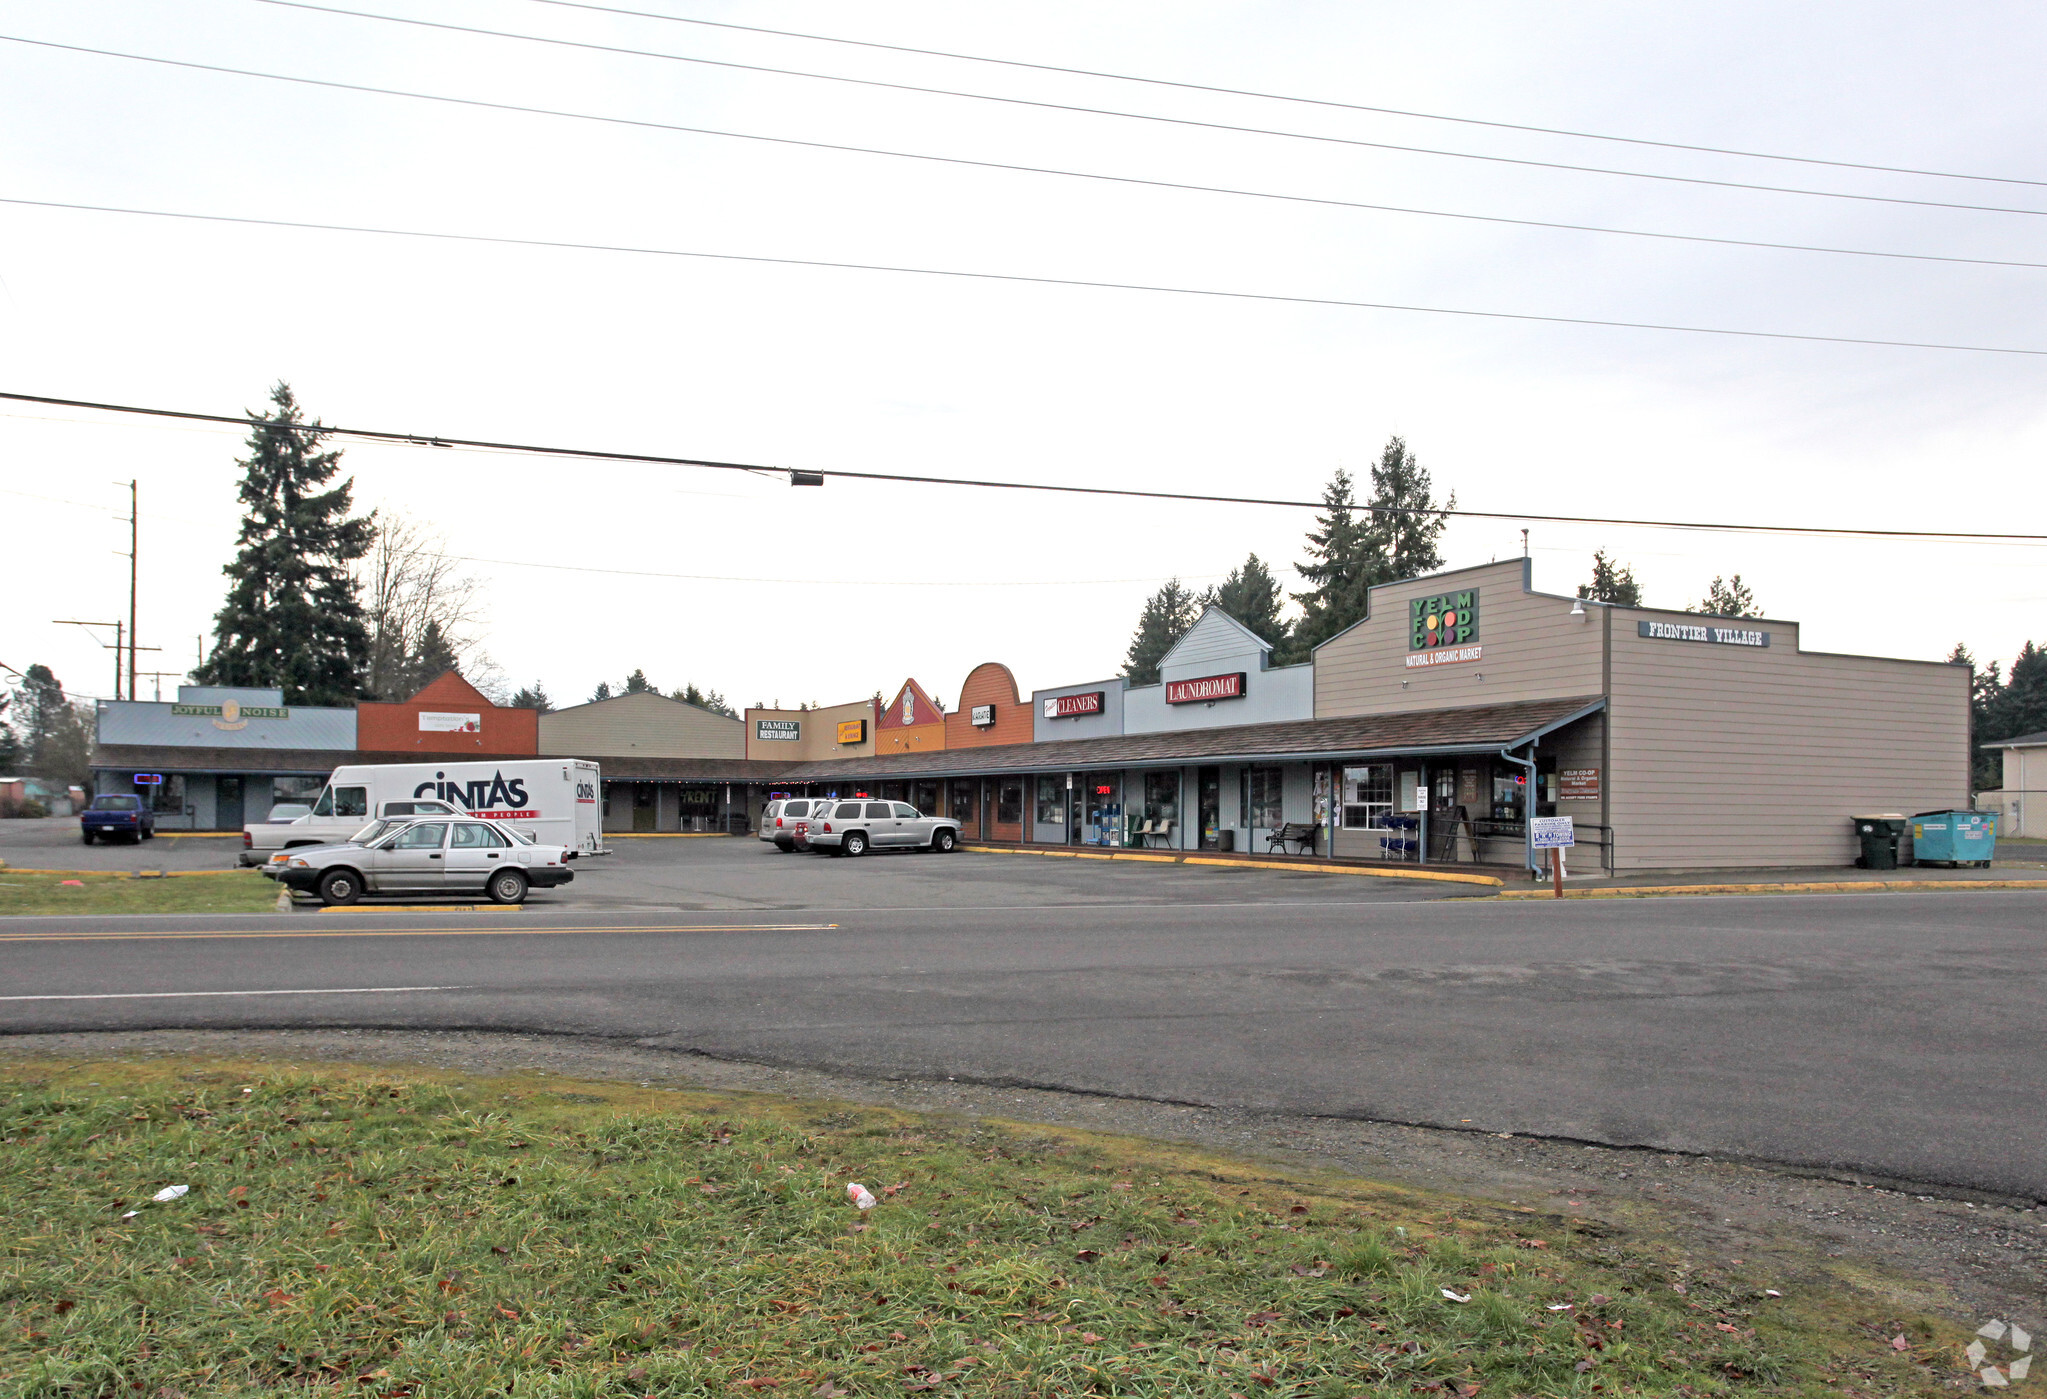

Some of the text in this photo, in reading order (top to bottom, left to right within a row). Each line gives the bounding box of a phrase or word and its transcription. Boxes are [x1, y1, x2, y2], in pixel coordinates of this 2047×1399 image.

[1412, 592, 1472, 616] YELM
[1414, 610, 1471, 632] FOOD
[1649, 622, 1762, 646] FRONTIER VILLAGE
[1406, 647, 1482, 667] NATURAL & ORGANIC MARKET
[1170, 677, 1237, 700] LAUNDROMAT
[174, 706, 287, 717] JOYFUL NOISE
[1058, 695, 1097, 713] CLEANERS
[760, 730, 798, 740] RESTAURANT
[762, 722, 795, 730] FAMILY
[1097, 786, 1110, 794] OPEN
